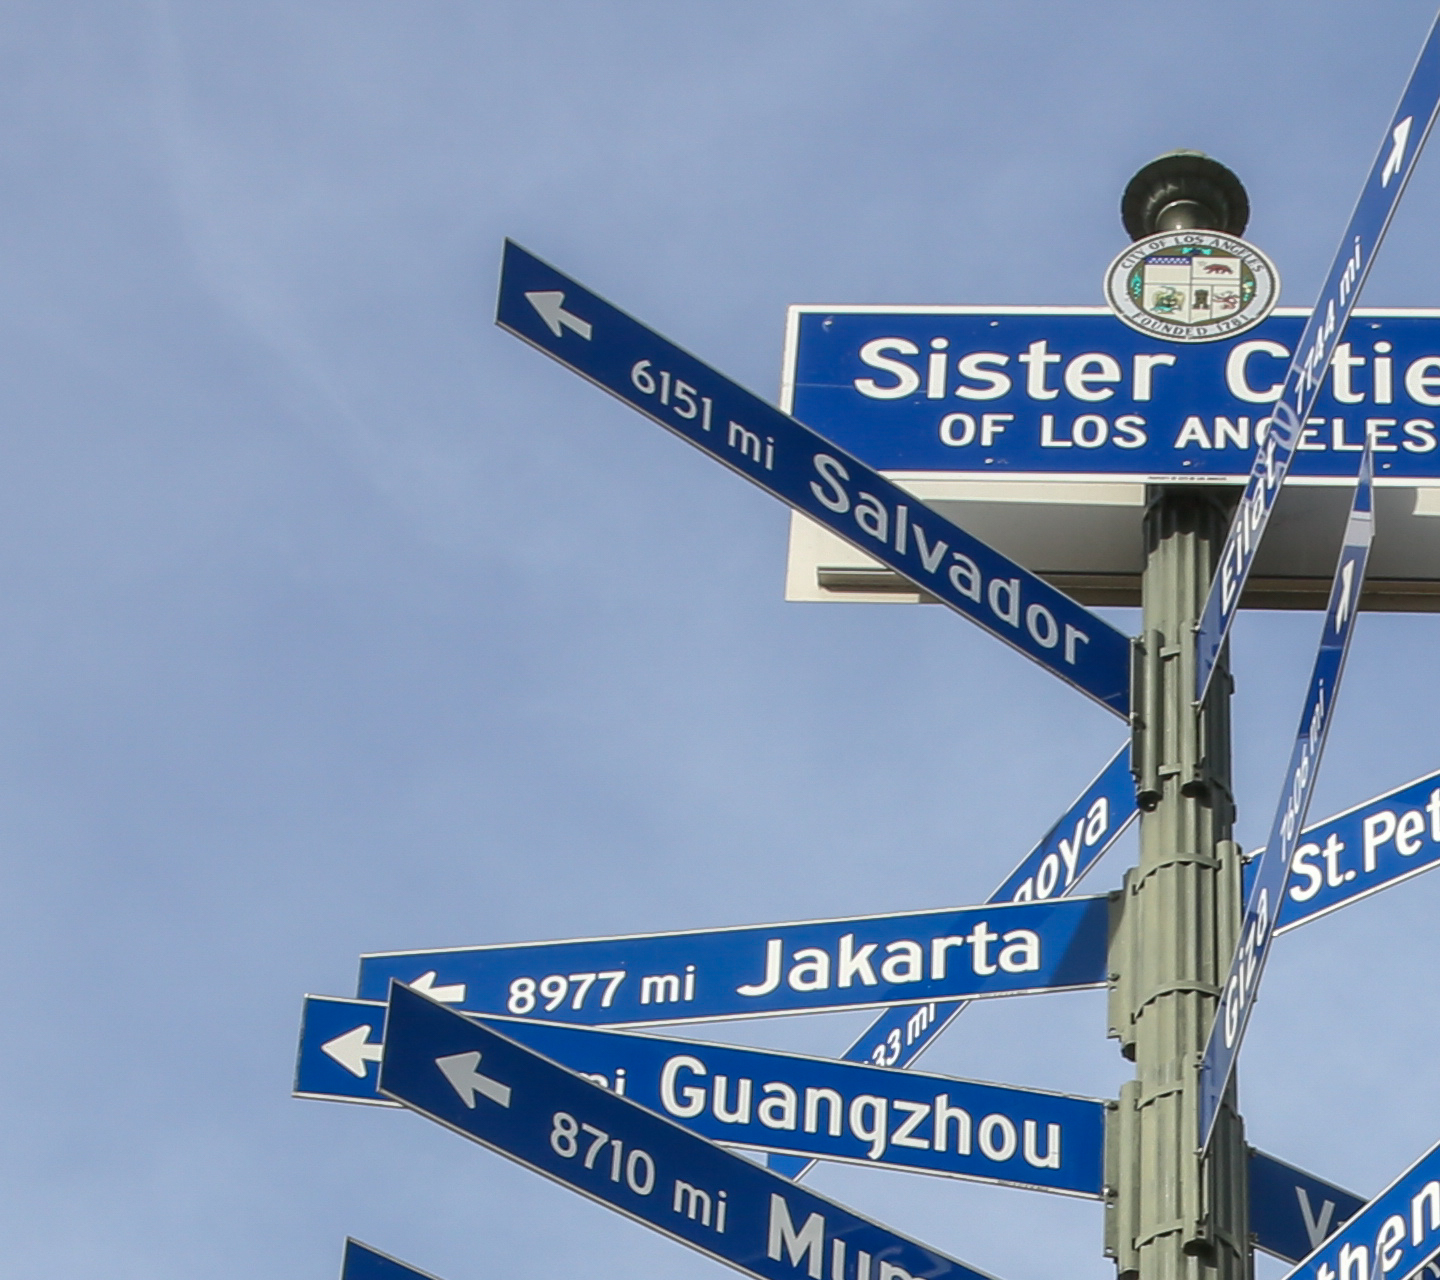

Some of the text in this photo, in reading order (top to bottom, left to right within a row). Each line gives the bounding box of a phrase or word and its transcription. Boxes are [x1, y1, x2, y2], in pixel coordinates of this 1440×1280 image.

[1121, 235, 1266, 273] CITY OF LOS ANGELES
[854, 336, 1177, 402] Sister
[1132, 312, 1250, 336] FOUNDED 1781
[939, 414, 1015, 448] OF
[1040, 414, 1149, 449] LOS
[1222, 438, 1277, 616] Eilat
[1340, 235, 1361, 307] mi
[630, 359, 1089, 664] 6151 mi Salvador
[1224, 888, 1270, 1050] Giza
[1310, 679, 1325, 755] mi
[1288, 831, 1357, 903] St.
[507, 921, 1041, 1015] 8977 mi Jakarta
[659, 1054, 1063, 1171] Guangzhou
[549, 1110, 655, 1198] 8710
[674, 1177, 727, 1234] mi
